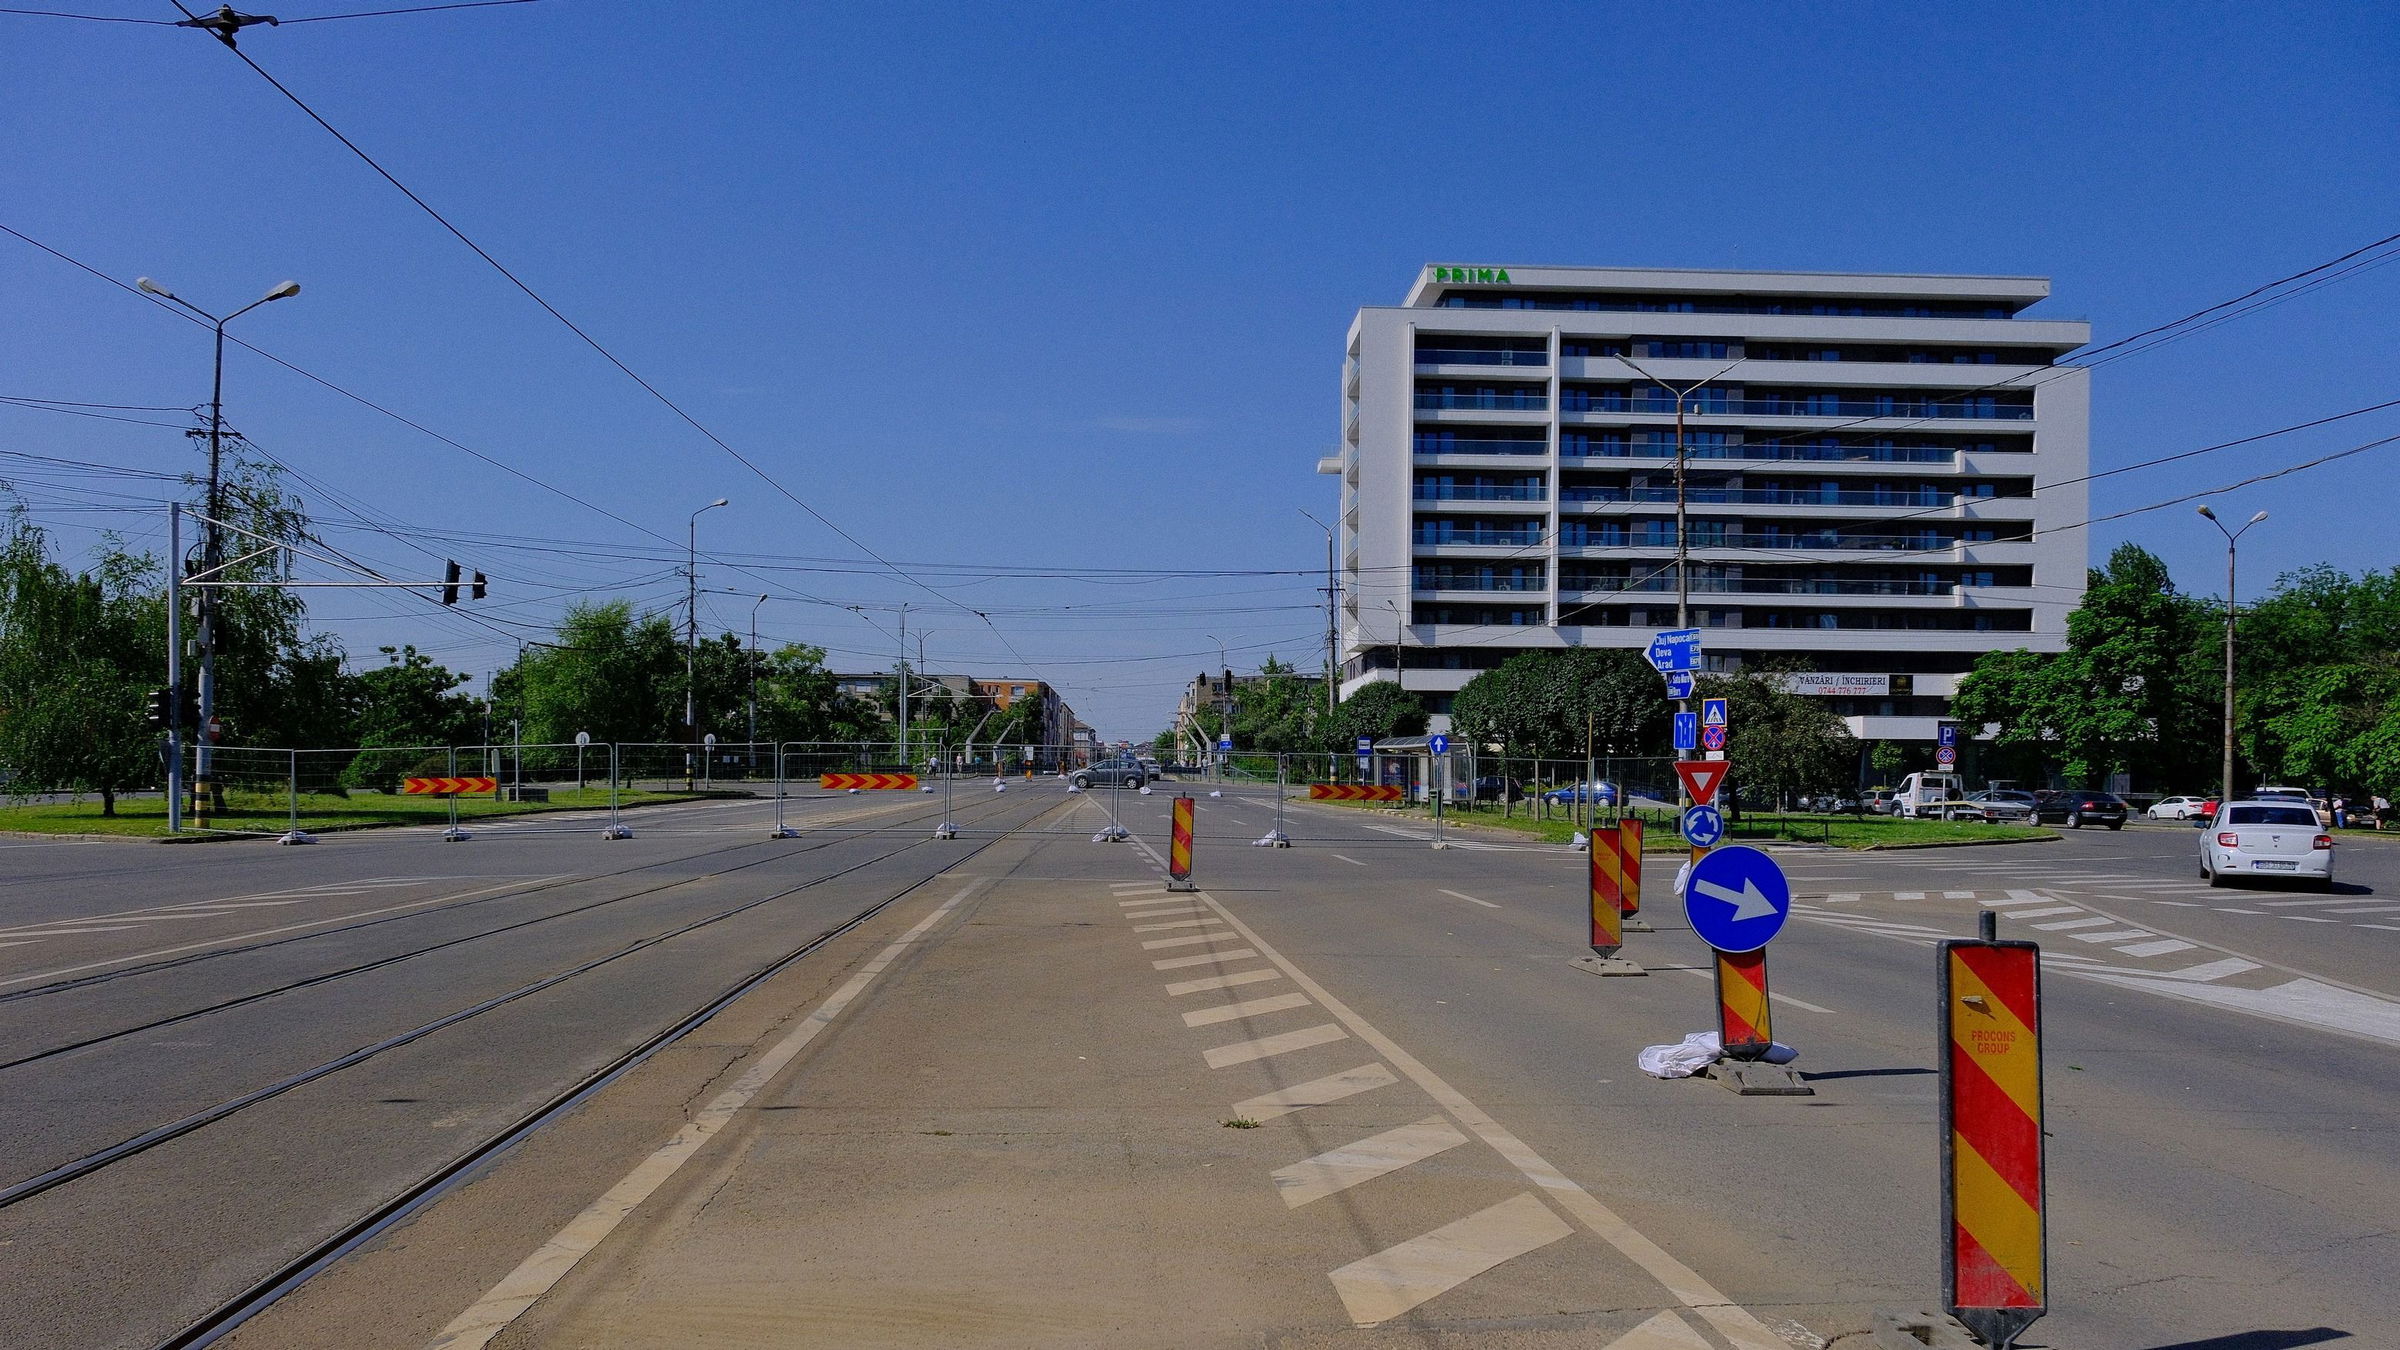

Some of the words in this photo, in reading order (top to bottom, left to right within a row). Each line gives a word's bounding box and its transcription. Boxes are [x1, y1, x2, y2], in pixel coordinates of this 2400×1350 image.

[1436, 266, 1511, 283] PRIMA
[1655, 636, 1667, 646] Cluj
[1667, 634, 1689, 645] Napoca
[1655, 648, 1672, 658] Deva
[1657, 659, 1673, 669] Arad
[1818, 686, 1836, 695] 0744
[1838, 686, 1851, 695] 776
[1853, 686, 1867, 695] 777
[1943, 728, 1952, 741] P
[1971, 1030, 2016, 1042] PROCONS
[1977, 1043, 2010, 1054] GROUP
